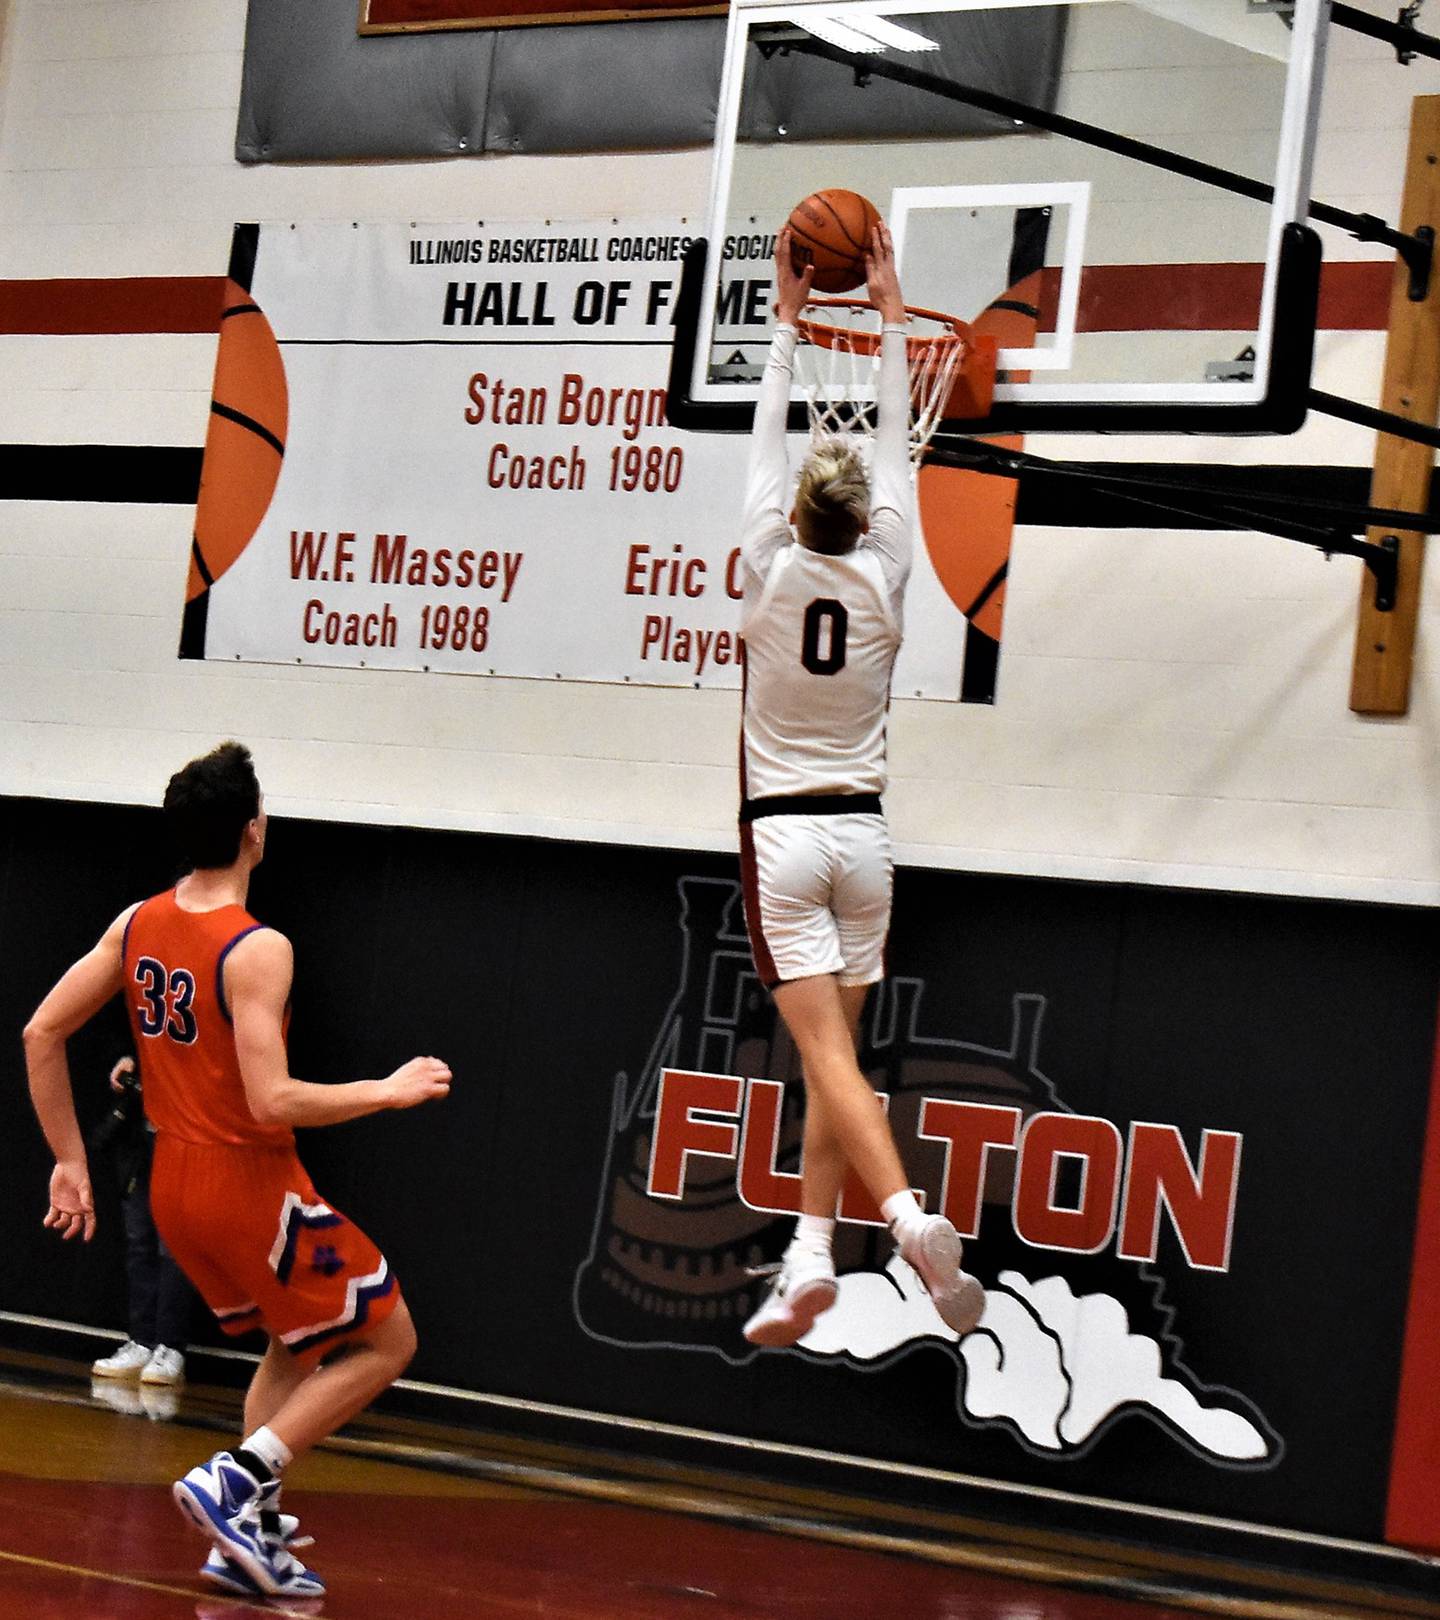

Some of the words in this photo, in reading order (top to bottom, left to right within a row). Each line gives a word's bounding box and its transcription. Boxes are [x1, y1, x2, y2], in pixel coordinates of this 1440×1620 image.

[409, 239, 482, 264] ILLINOIS
[488, 237, 599, 263] BASKETBALL
[442, 281, 556, 326] HALL
[572, 280, 632, 326] OF
[645, 279, 772, 326] FME
[464, 372, 547, 425] Stan
[487, 443, 586, 490] Coach
[608, 445, 683, 493] 1980
[289, 531, 357, 583] W.F.
[370, 534, 524, 603] Massey
[624, 543, 707, 598] Eric
[303, 599, 398, 648] Coach
[418, 604, 490, 652] 1988
[801, 597, 848, 676] 0
[134, 955, 199, 1045] 33
